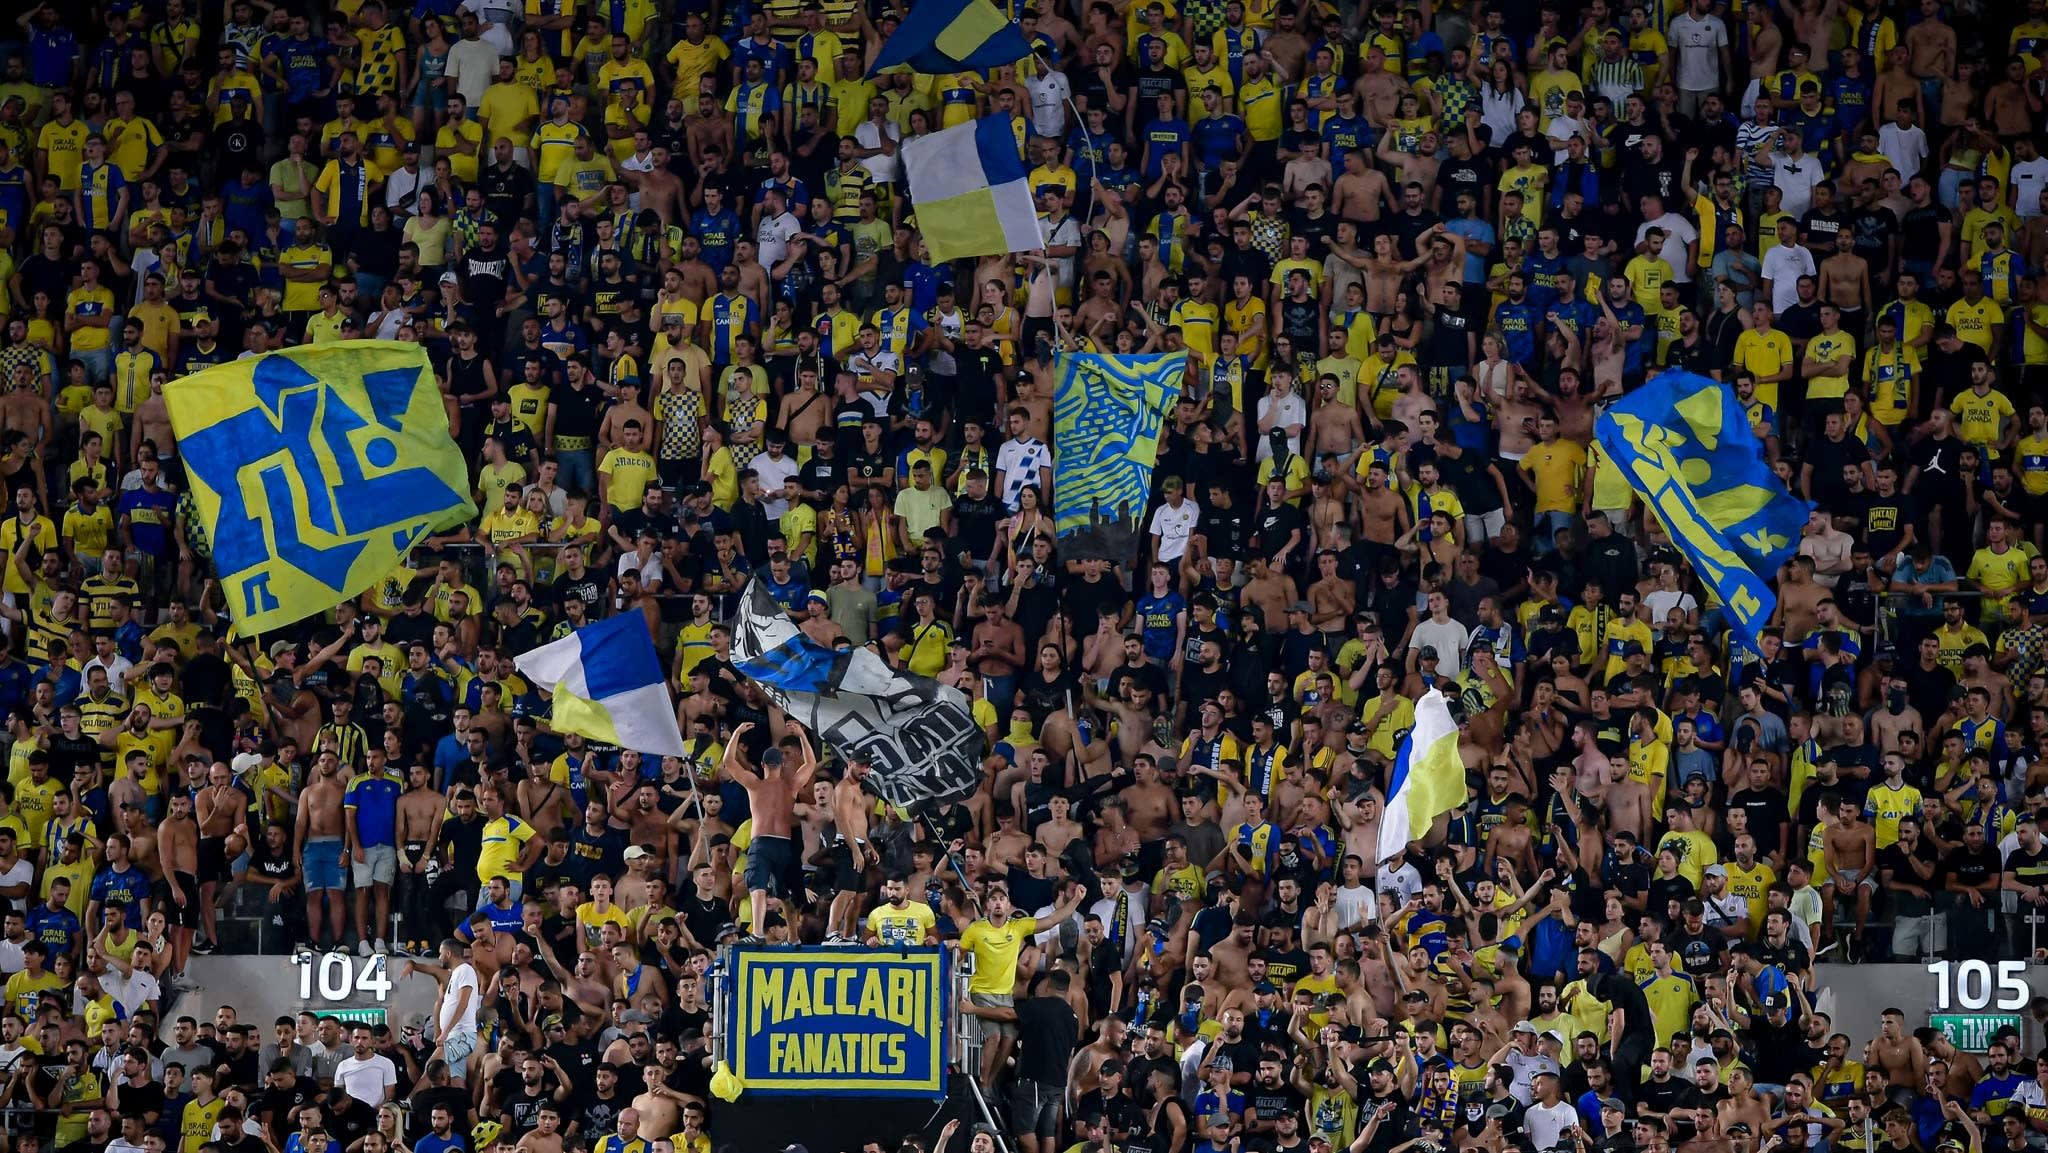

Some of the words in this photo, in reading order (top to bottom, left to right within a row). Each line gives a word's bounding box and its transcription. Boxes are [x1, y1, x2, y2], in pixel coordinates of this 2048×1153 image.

[615, 456, 652, 469] Maccab
[1733, 884, 1759, 892] ISRAEL
[491, 920, 523, 928] Champion
[42, 929, 66, 937] ISRAEL
[40, 936, 68, 945] CANADA
[291, 951, 393, 1001] 104
[1927, 958, 2030, 1011] 105
[751, 967, 926, 1038] MACCABI
[769, 1032, 906, 1074] FANATICS
